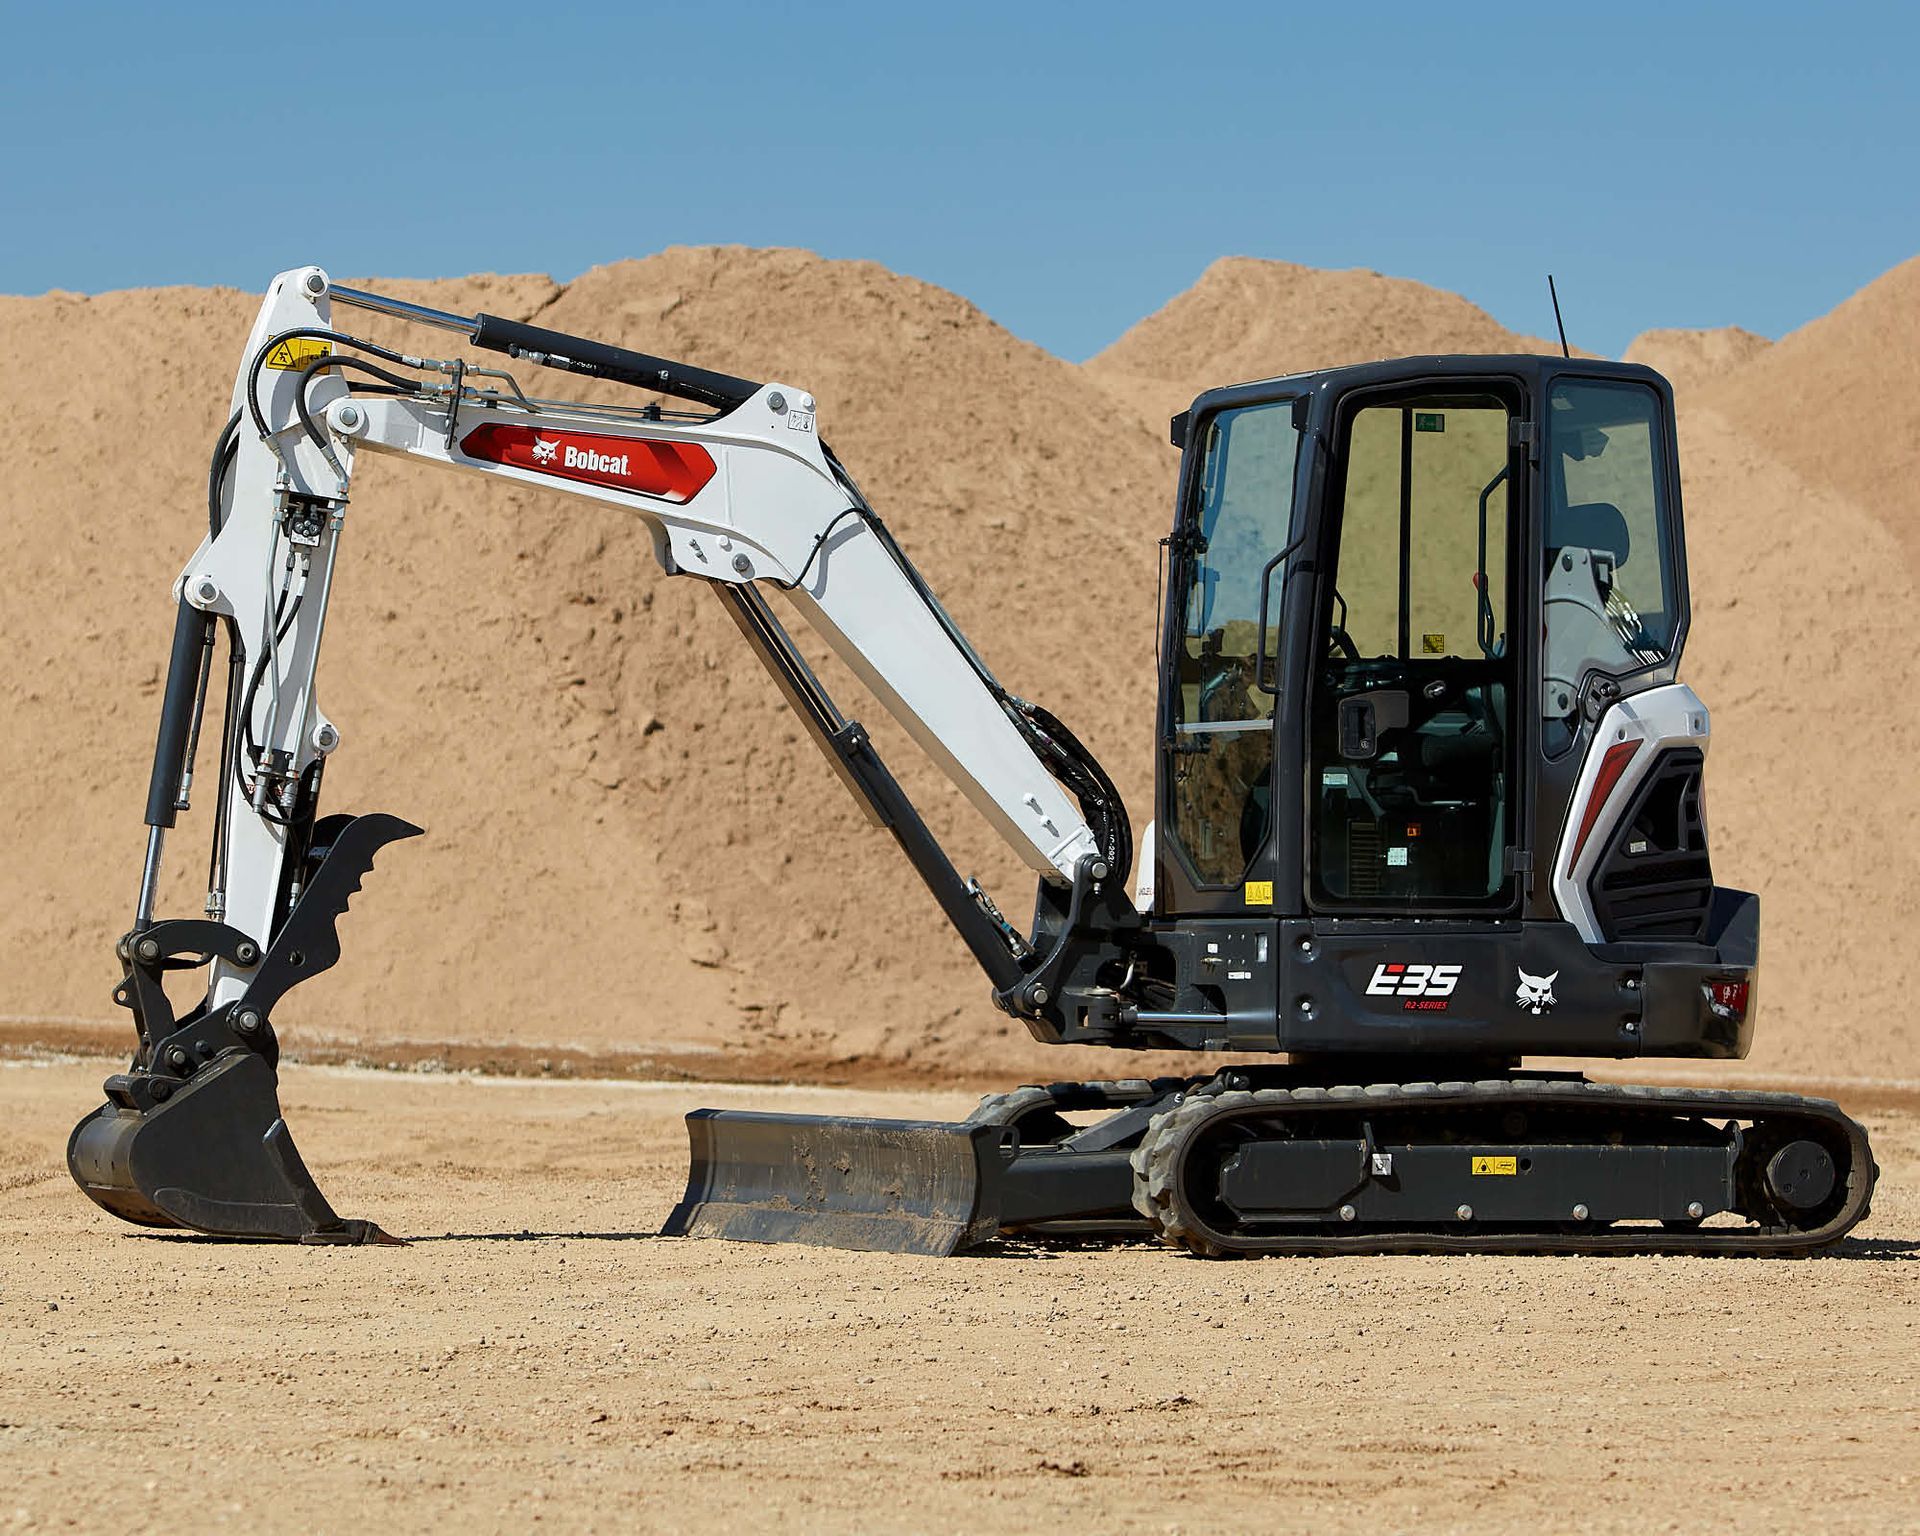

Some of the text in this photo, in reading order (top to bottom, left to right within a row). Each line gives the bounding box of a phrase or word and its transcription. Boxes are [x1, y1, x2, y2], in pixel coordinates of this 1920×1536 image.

[564, 445, 629, 476] Bobcat
[1365, 964, 1463, 996] E35
[1404, 1001, 1448, 1010] R2-SERIES
